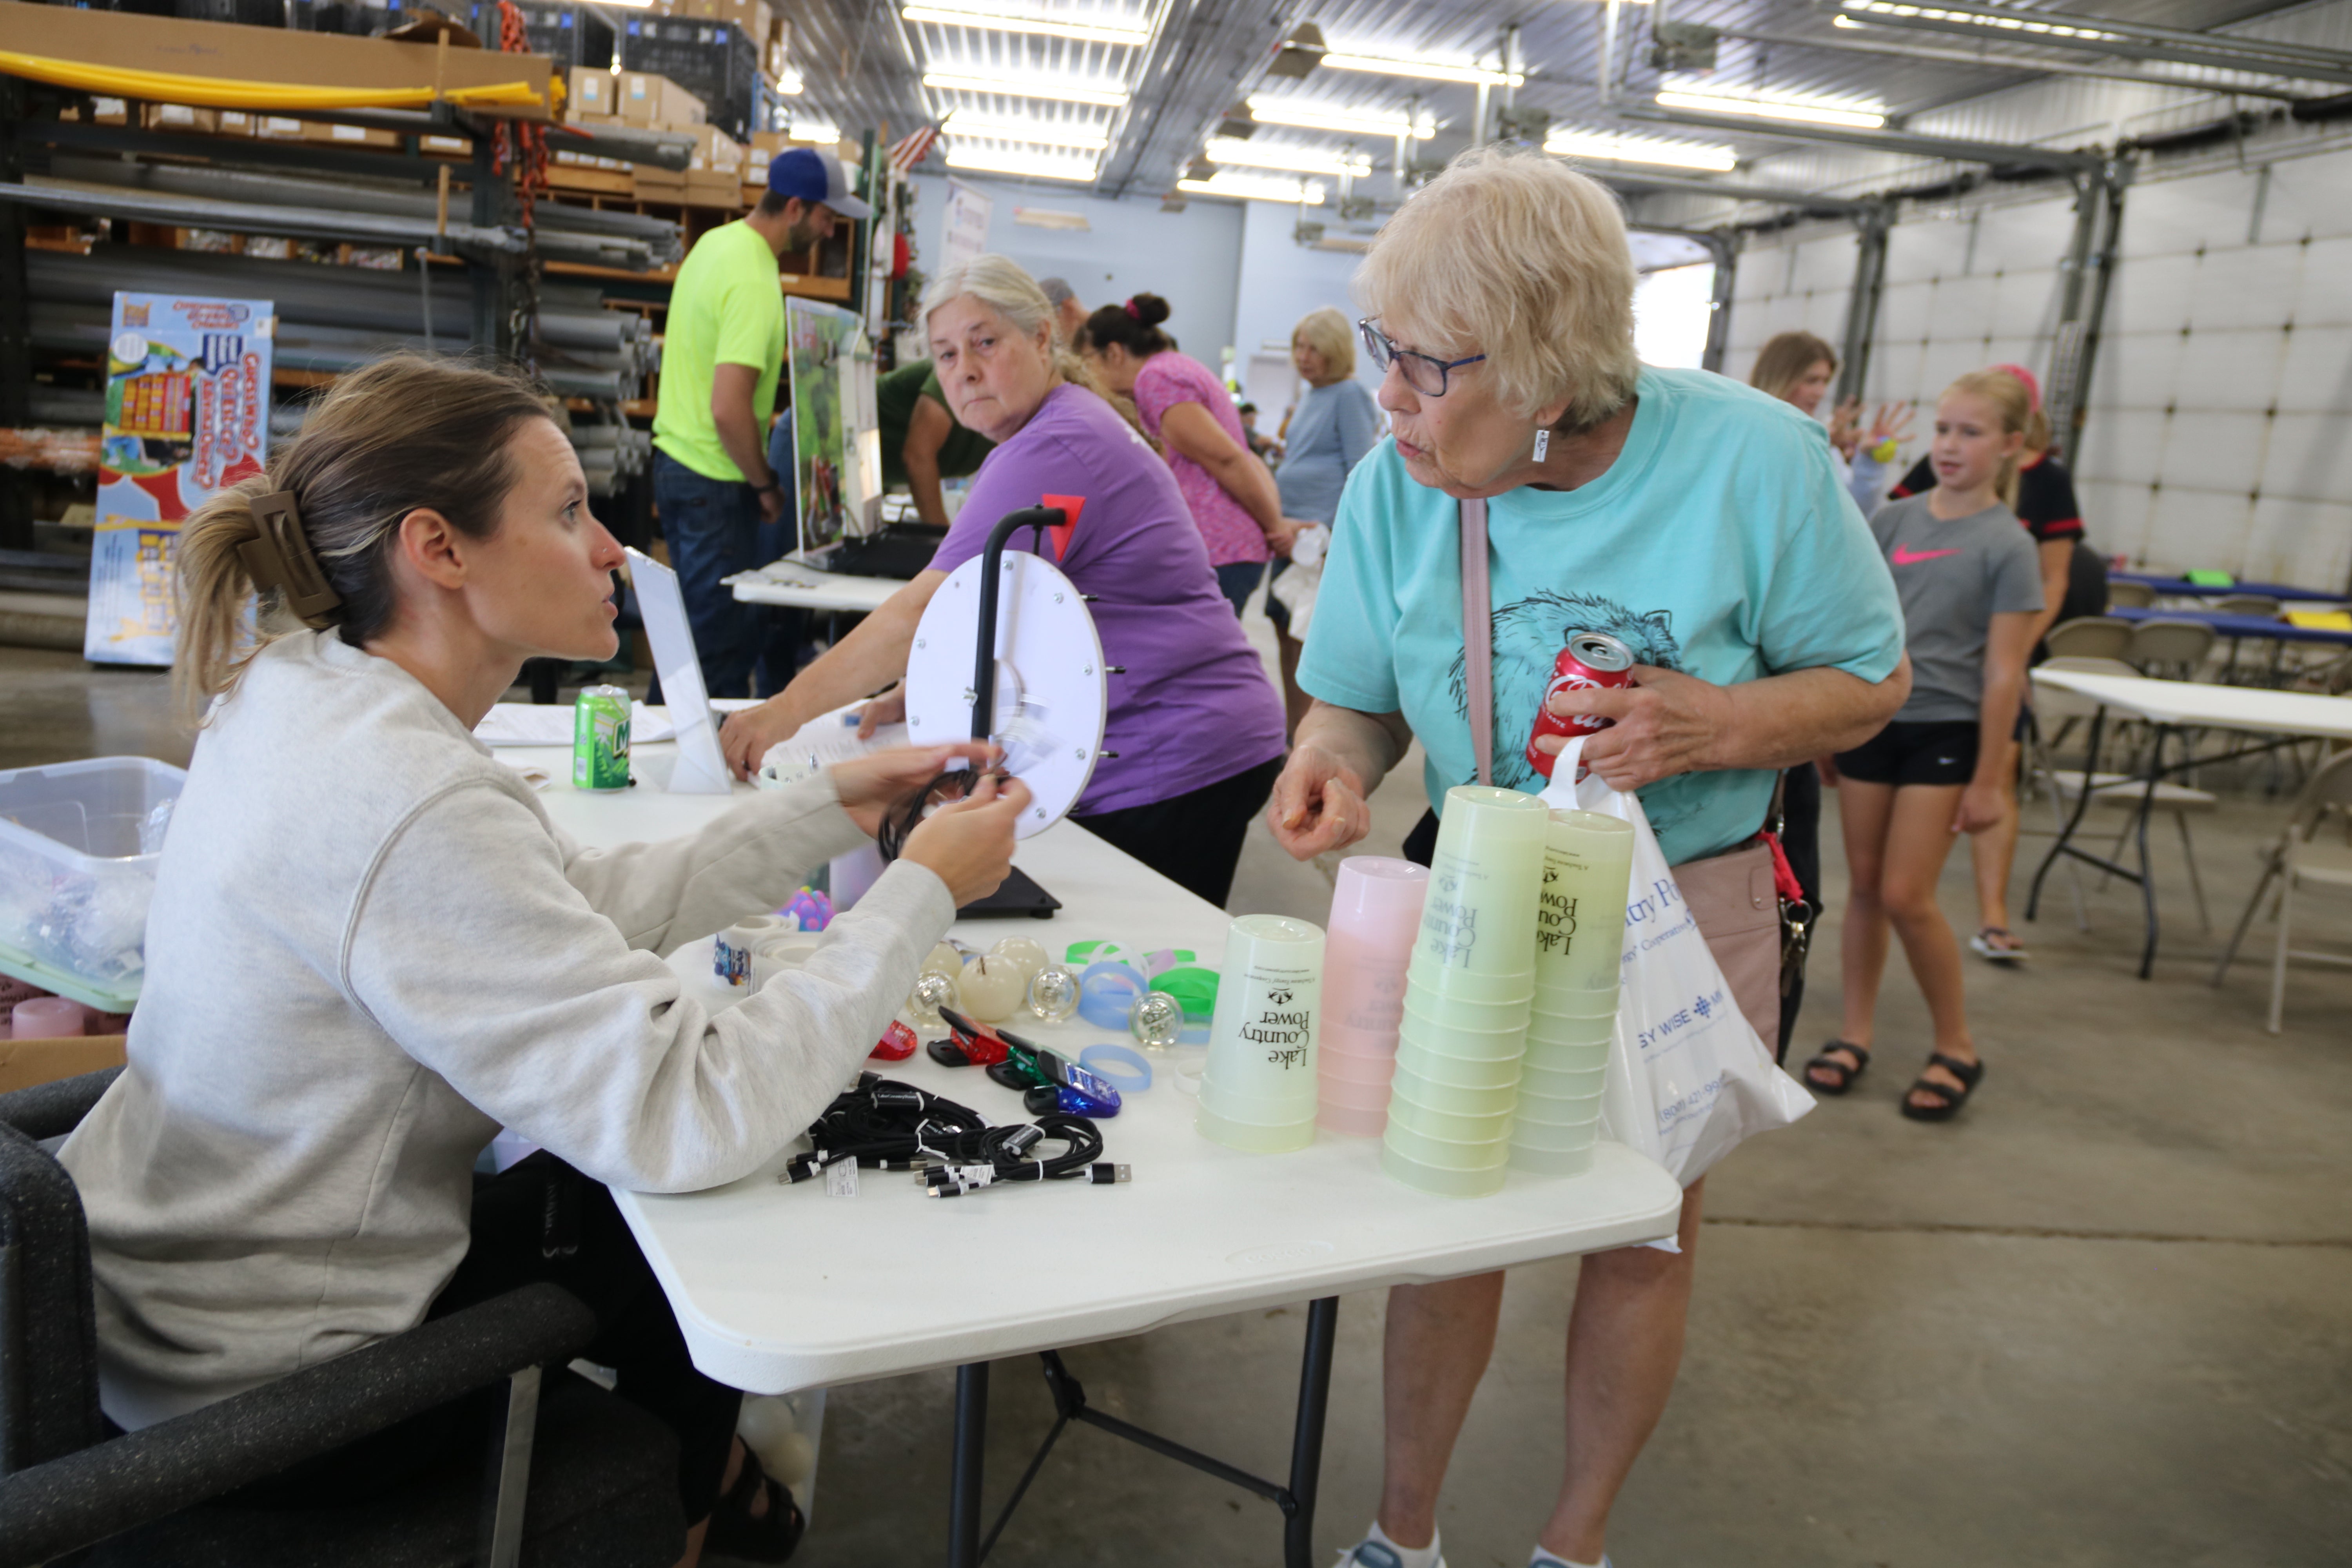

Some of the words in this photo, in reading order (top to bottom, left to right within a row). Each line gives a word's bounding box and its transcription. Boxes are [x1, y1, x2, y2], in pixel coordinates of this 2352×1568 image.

[1430, 897, 1478, 929] Power
[1430, 938, 1472, 969] Lake
[1537, 931, 1572, 956] Lak
[1259, 1011, 1310, 1030] Power
[1659, 1009, 1691, 1036] WISE
[1238, 1022, 1310, 1049] Country
[1268, 1049, 1307, 1070] Lake
